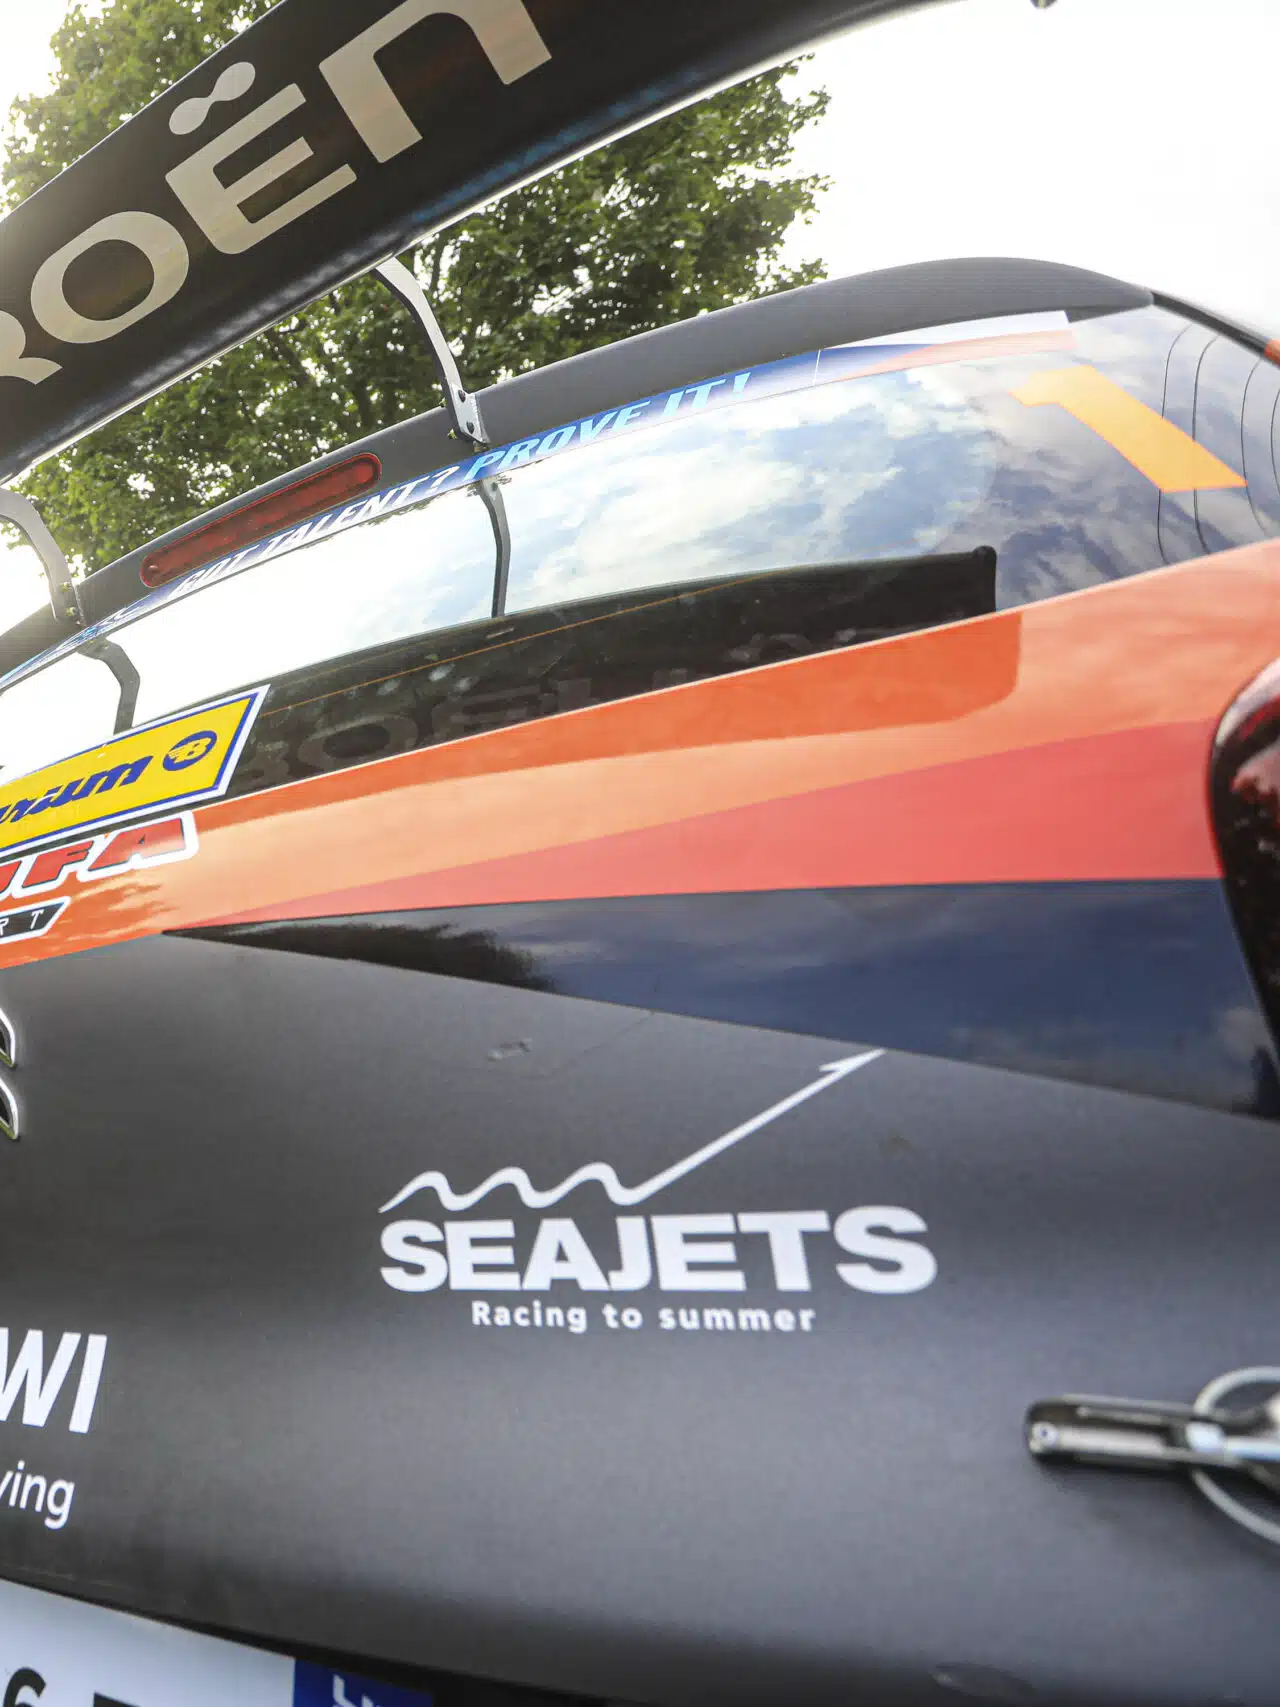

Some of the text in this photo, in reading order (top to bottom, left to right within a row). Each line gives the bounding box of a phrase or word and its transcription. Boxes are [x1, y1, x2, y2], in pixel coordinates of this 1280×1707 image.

[260, 466, 460, 562] TALENT?
[462, 399, 651, 482] PROVE
[380, 1206, 938, 1294] SEAJETS
[472, 1300, 816, 1334] Racing to summer
